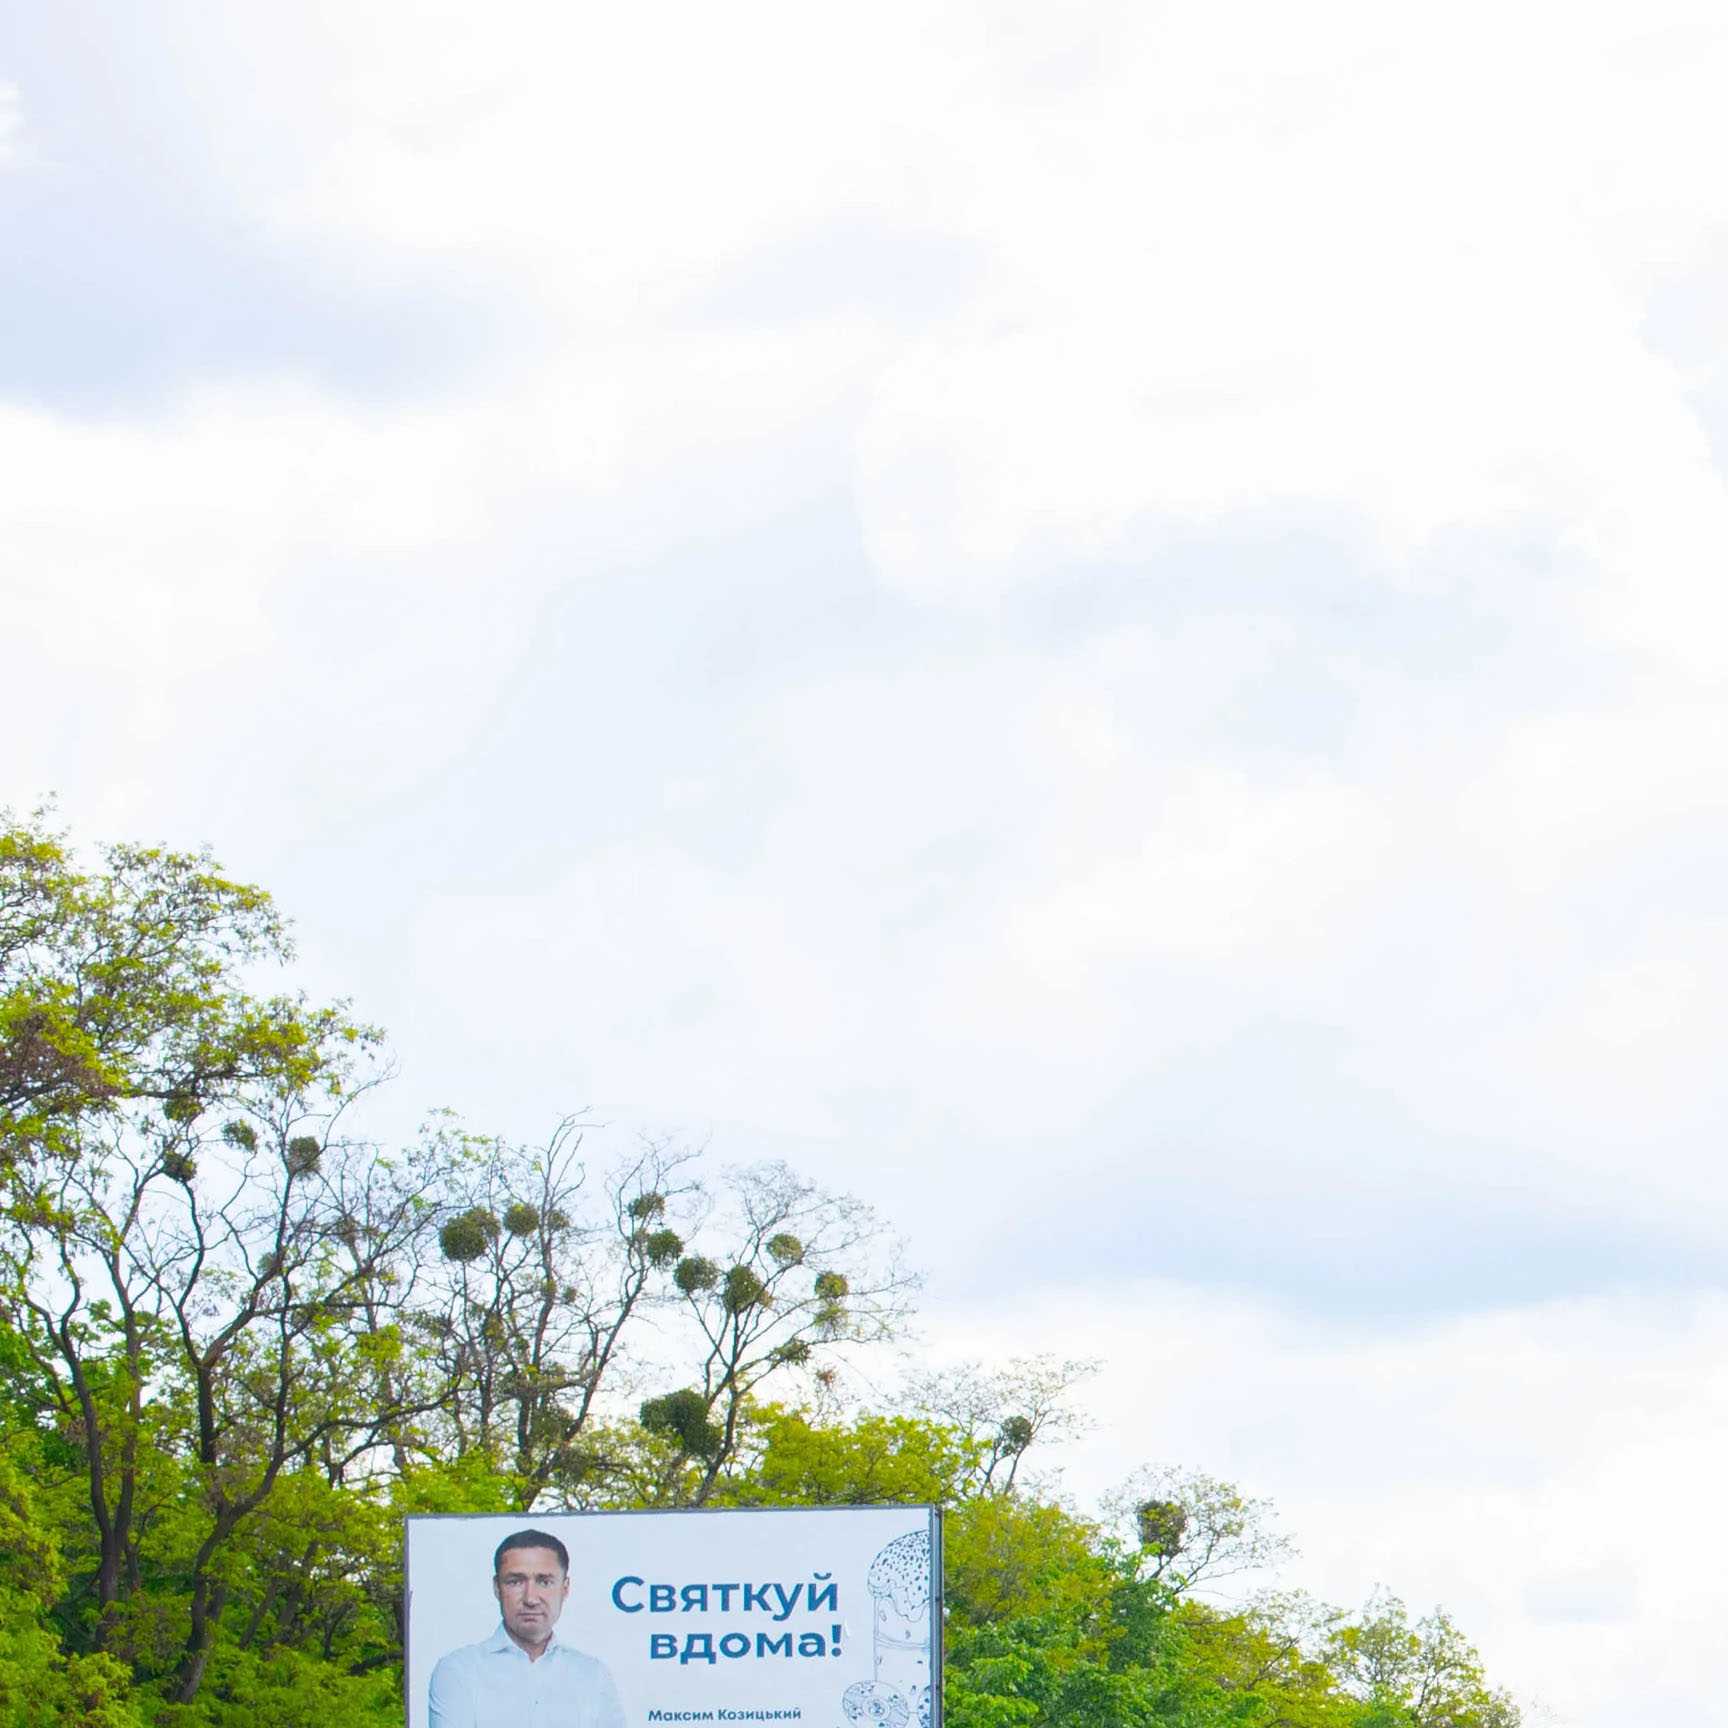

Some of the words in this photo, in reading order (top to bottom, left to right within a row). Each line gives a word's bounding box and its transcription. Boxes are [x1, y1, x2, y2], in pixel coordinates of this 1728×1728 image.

[611, 1572, 839, 1622] Святкуй
[650, 1624, 843, 1665] вдома!
[648, 1710, 714, 1721] Максим
[717, 1707, 801, 1721] Козицький
